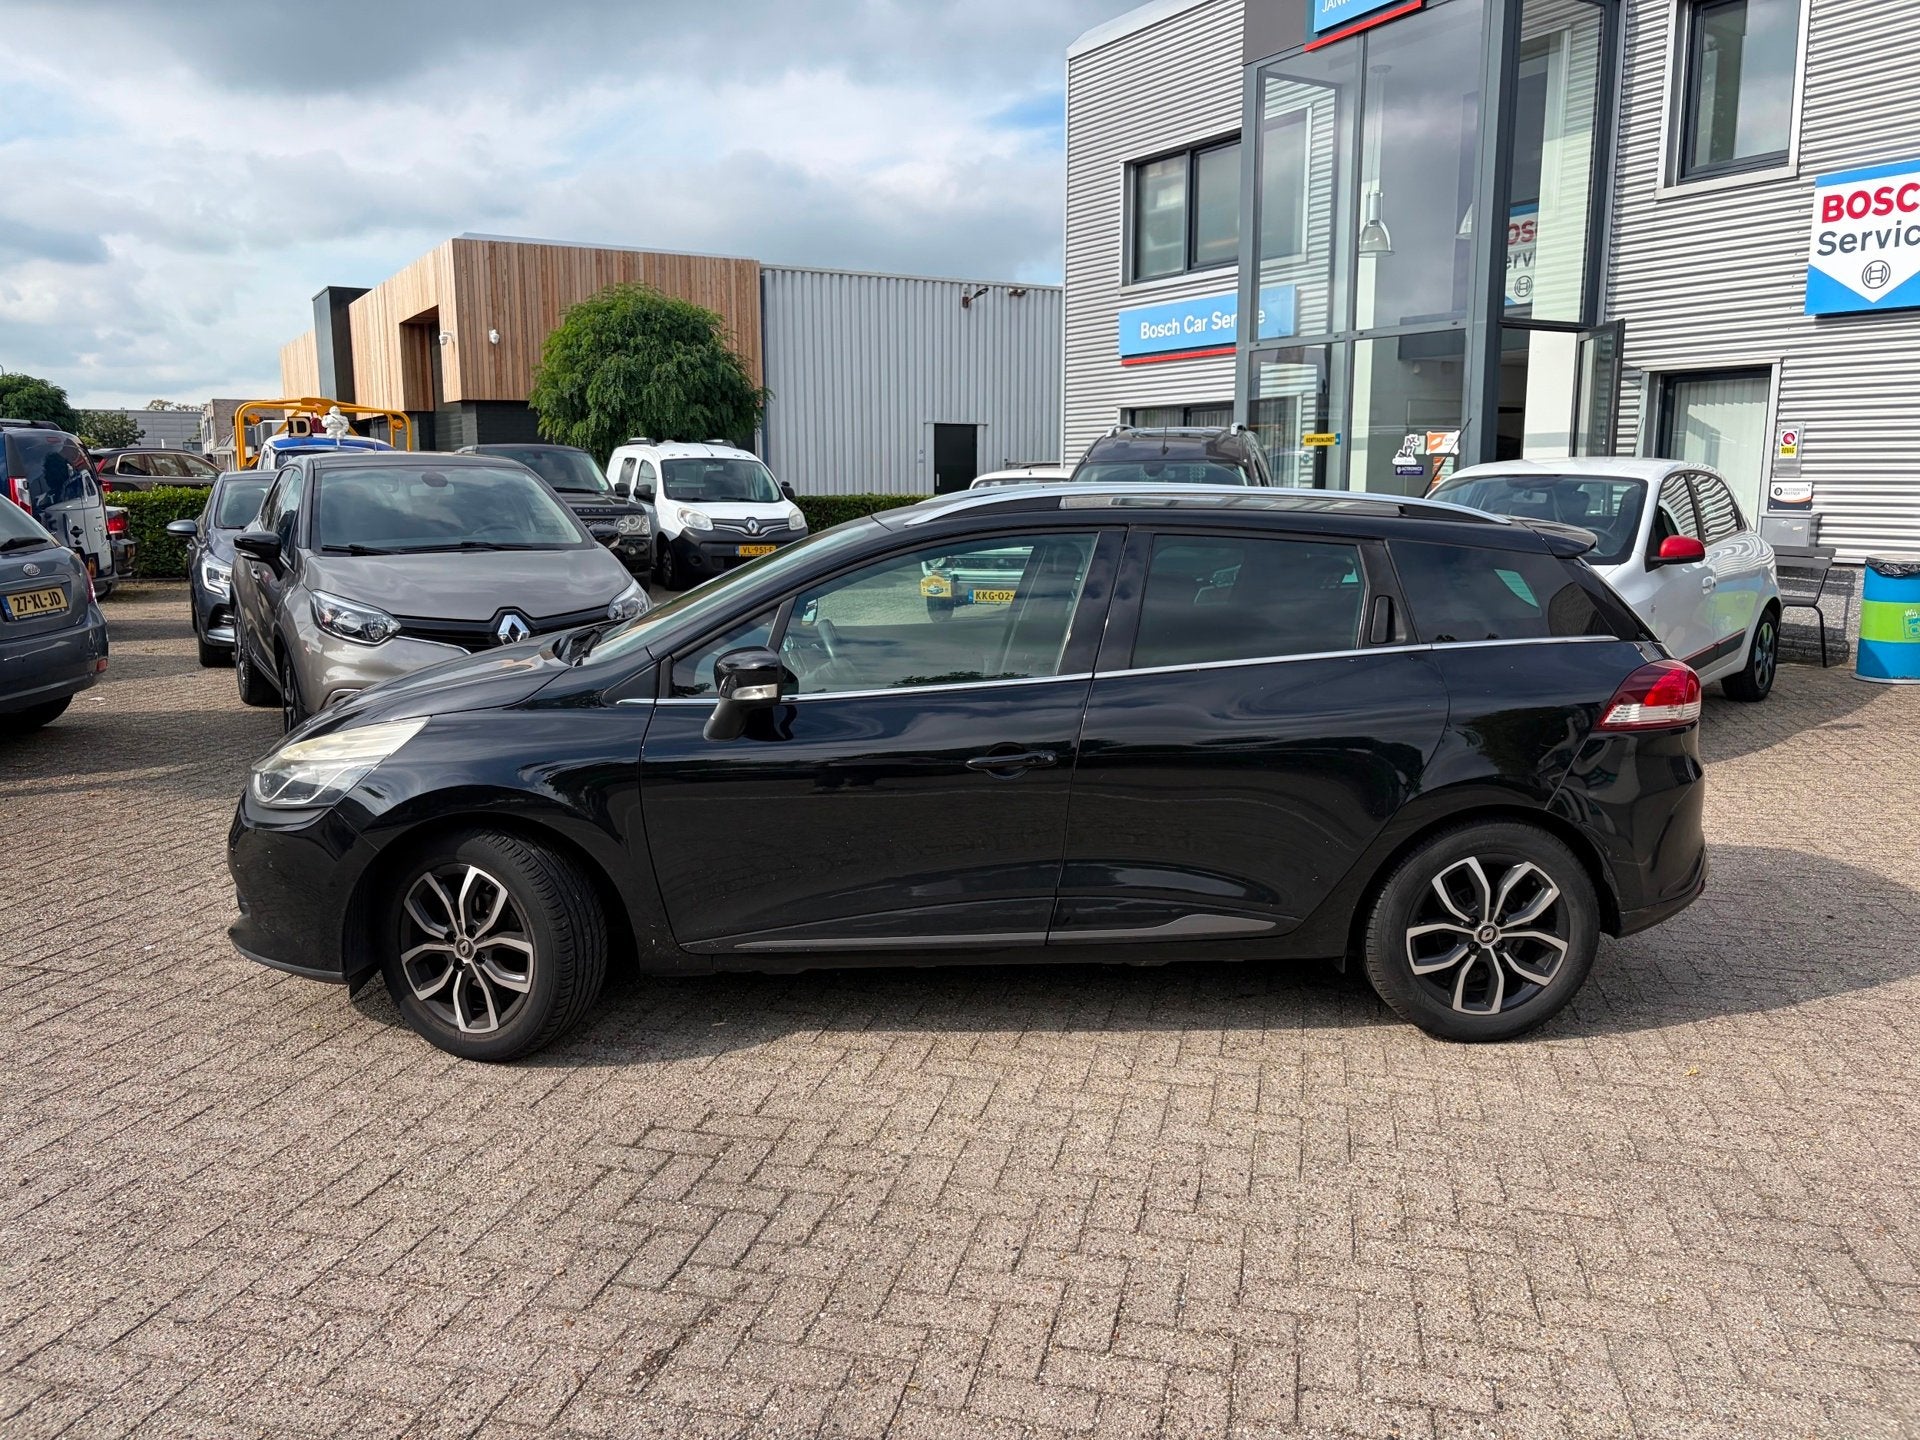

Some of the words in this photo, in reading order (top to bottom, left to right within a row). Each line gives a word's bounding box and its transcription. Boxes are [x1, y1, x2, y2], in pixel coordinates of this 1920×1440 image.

[1507, 220, 1536, 245] OS
[1140, 317, 1180, 340] Bosch
[1183, 314, 1207, 334] Car
[1211, 310, 1266, 330] Sere
[288, 416, 312, 437] D
[13, 591, 62, 612] 27-XL-JD
[975, 591, 1015, 601] KKG-02-
